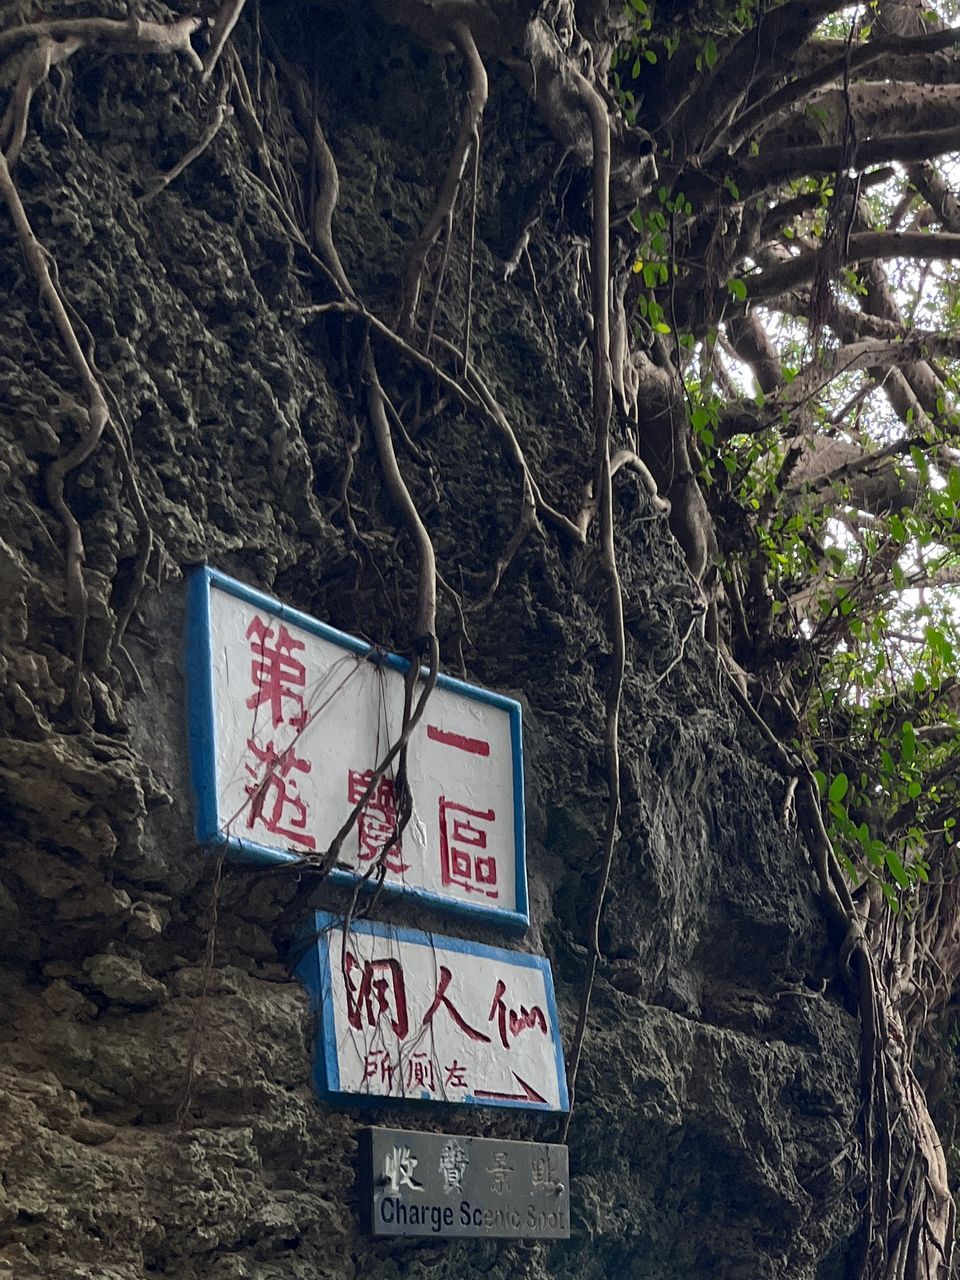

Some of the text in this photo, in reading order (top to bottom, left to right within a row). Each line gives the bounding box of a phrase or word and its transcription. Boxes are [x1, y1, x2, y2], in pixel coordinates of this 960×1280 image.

[380, 1196, 565, 1233] Charge Scenic Spot
